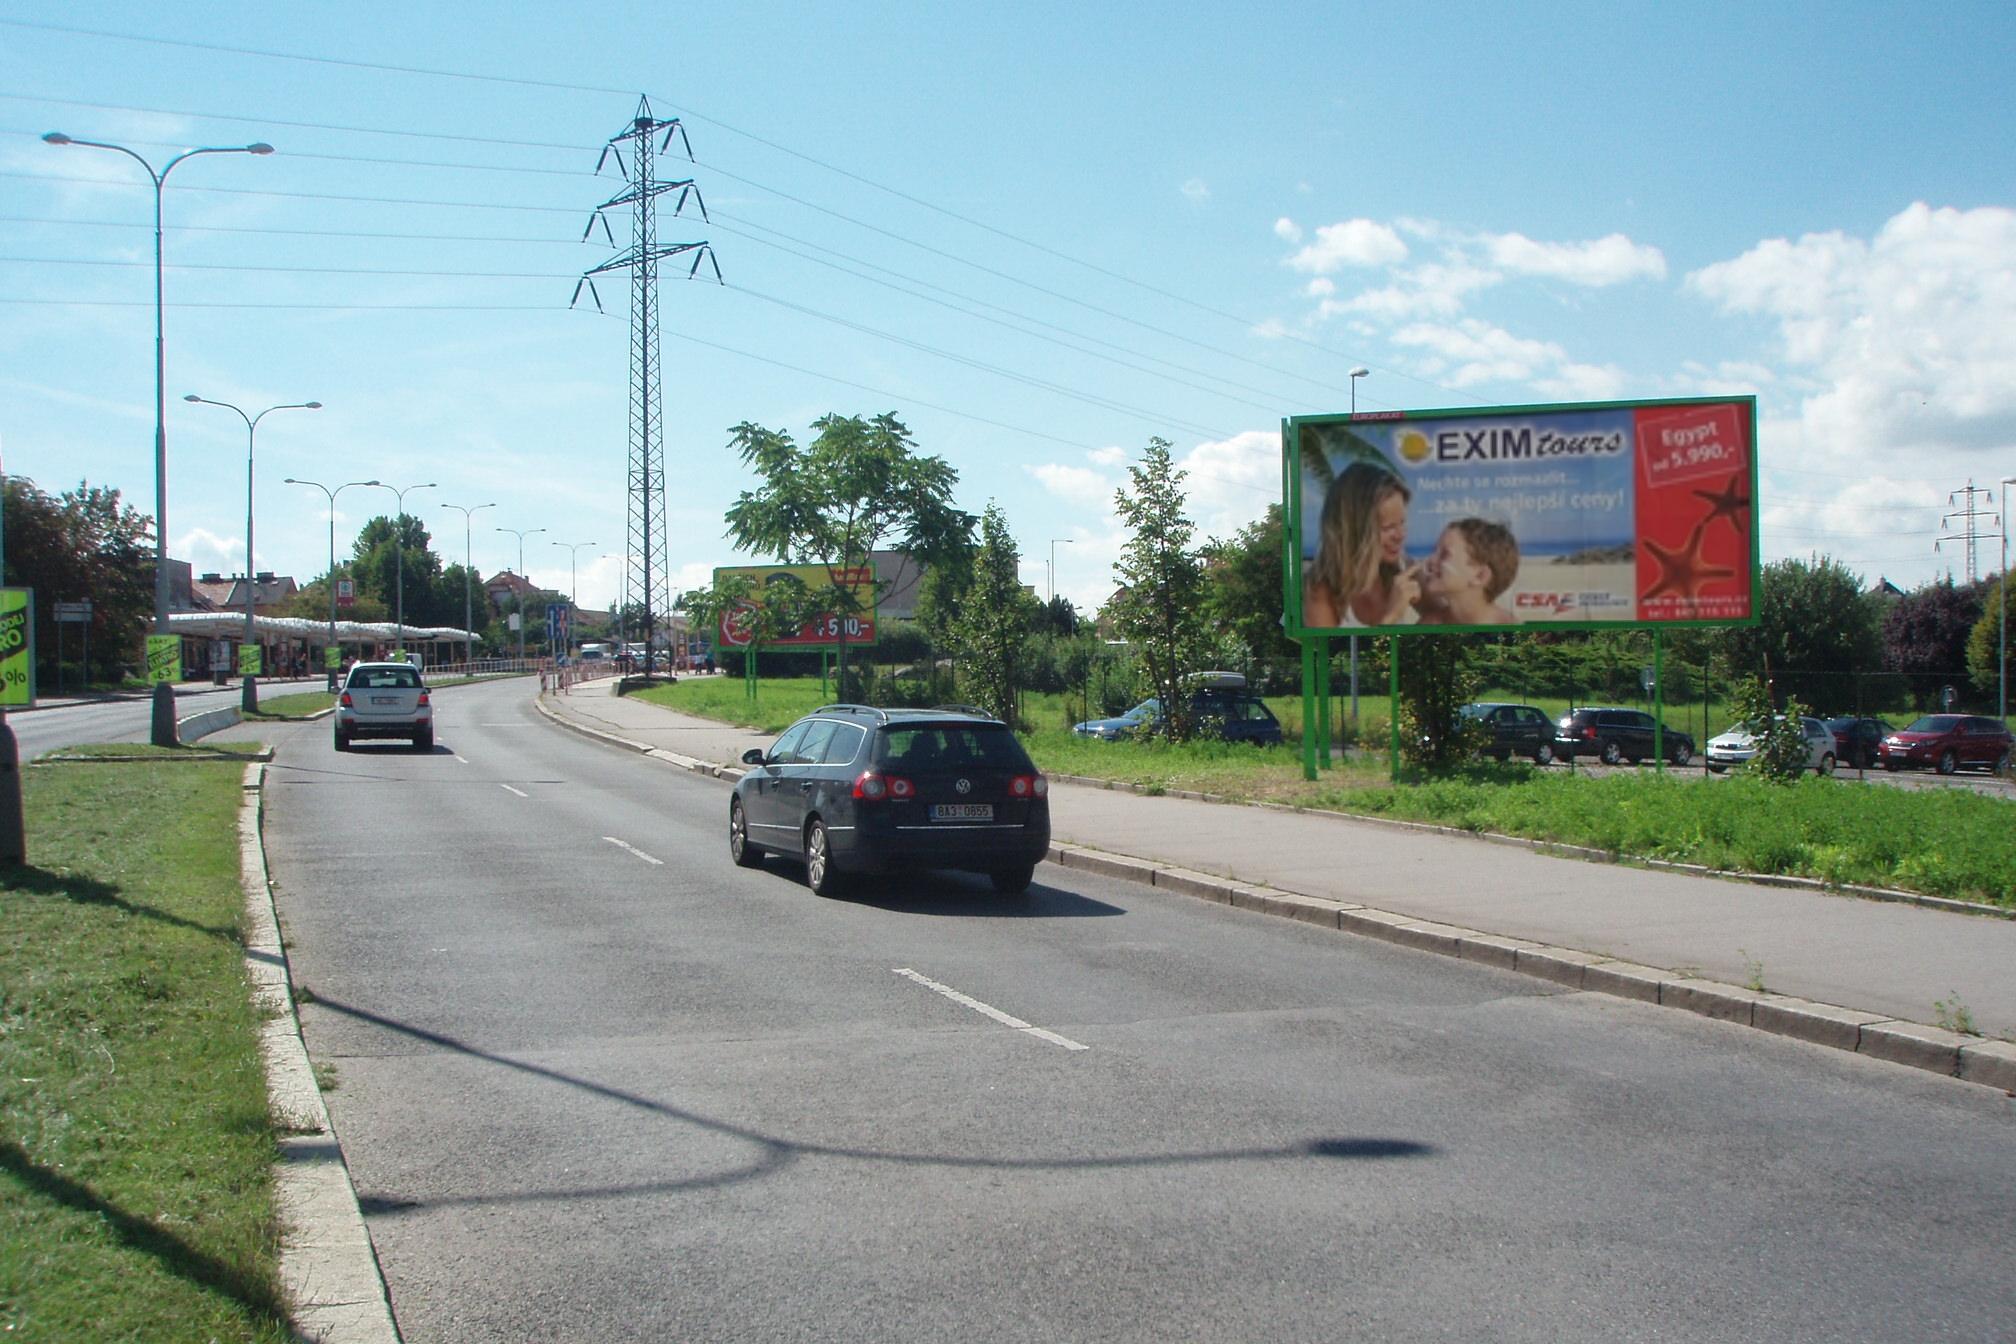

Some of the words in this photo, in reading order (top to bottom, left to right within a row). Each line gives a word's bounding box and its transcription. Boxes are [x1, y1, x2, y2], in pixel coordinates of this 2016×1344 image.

[1662, 421, 1718, 446] Egypt
[1437, 428, 1531, 461] EXIM
[1536, 431, 1621, 456] tours
[1474, 476, 1491, 488] se
[938, 806, 957, 817] 8A3
[964, 805, 989, 817] 0855
